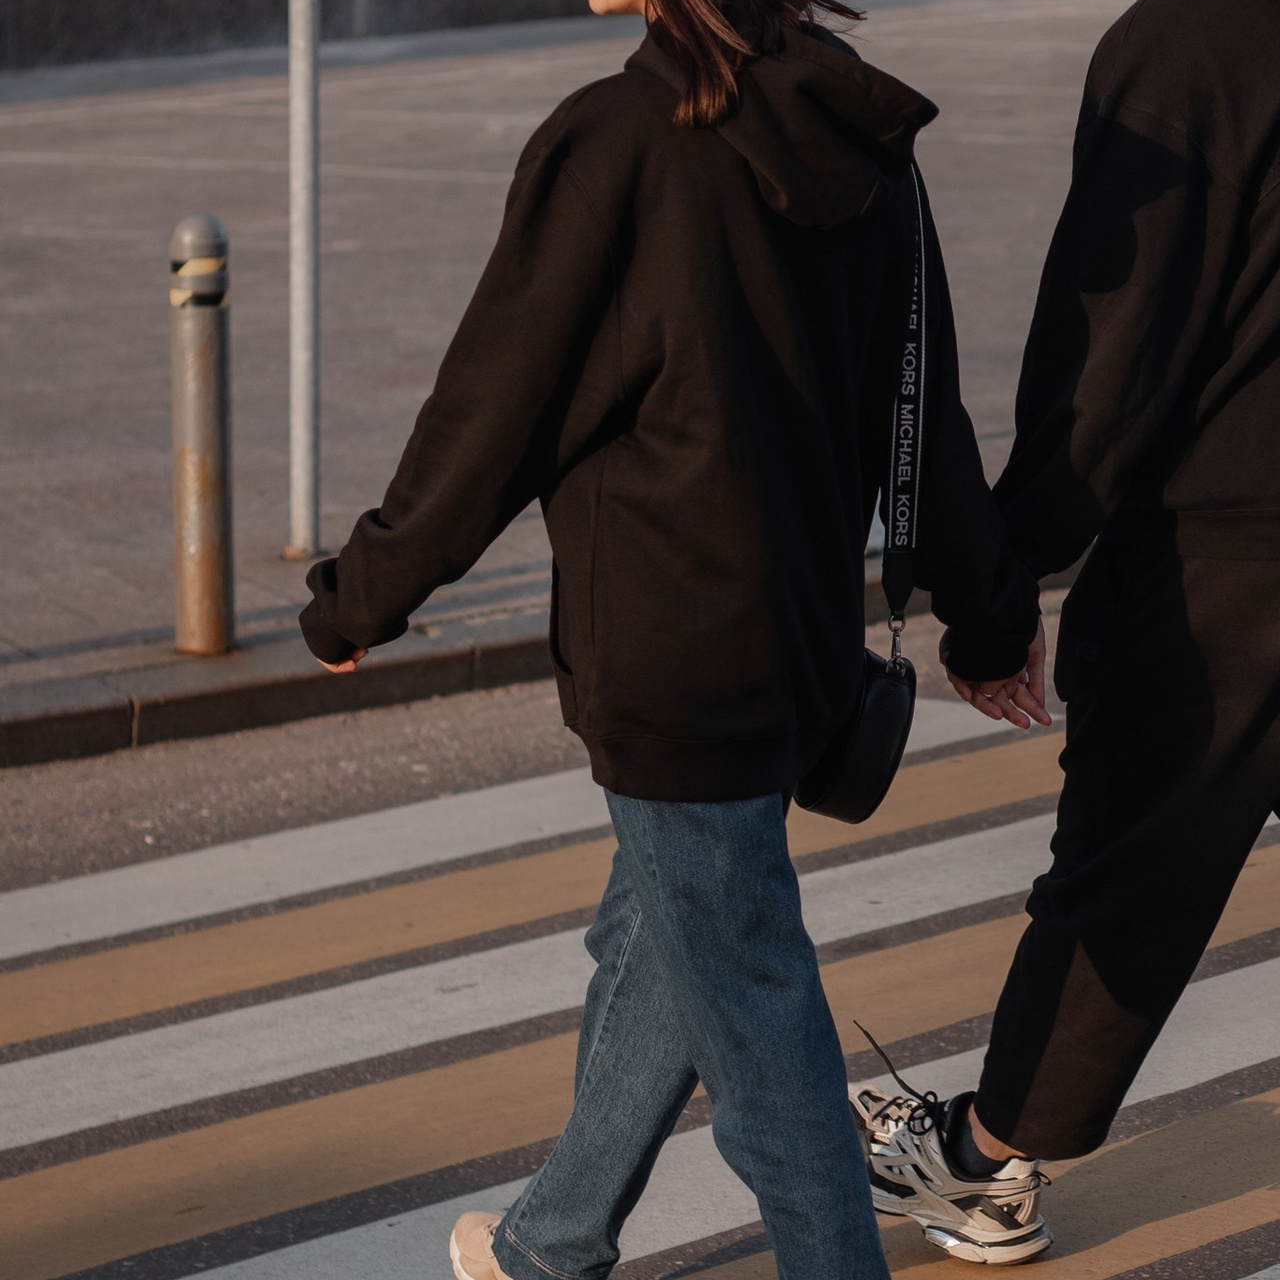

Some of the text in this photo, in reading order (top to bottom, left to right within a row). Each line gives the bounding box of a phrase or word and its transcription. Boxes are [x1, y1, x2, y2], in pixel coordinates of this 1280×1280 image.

[902, 342, 917, 396] KORS
[898, 404, 914, 487] MICHAEL
[895, 494, 910, 546] KORS
